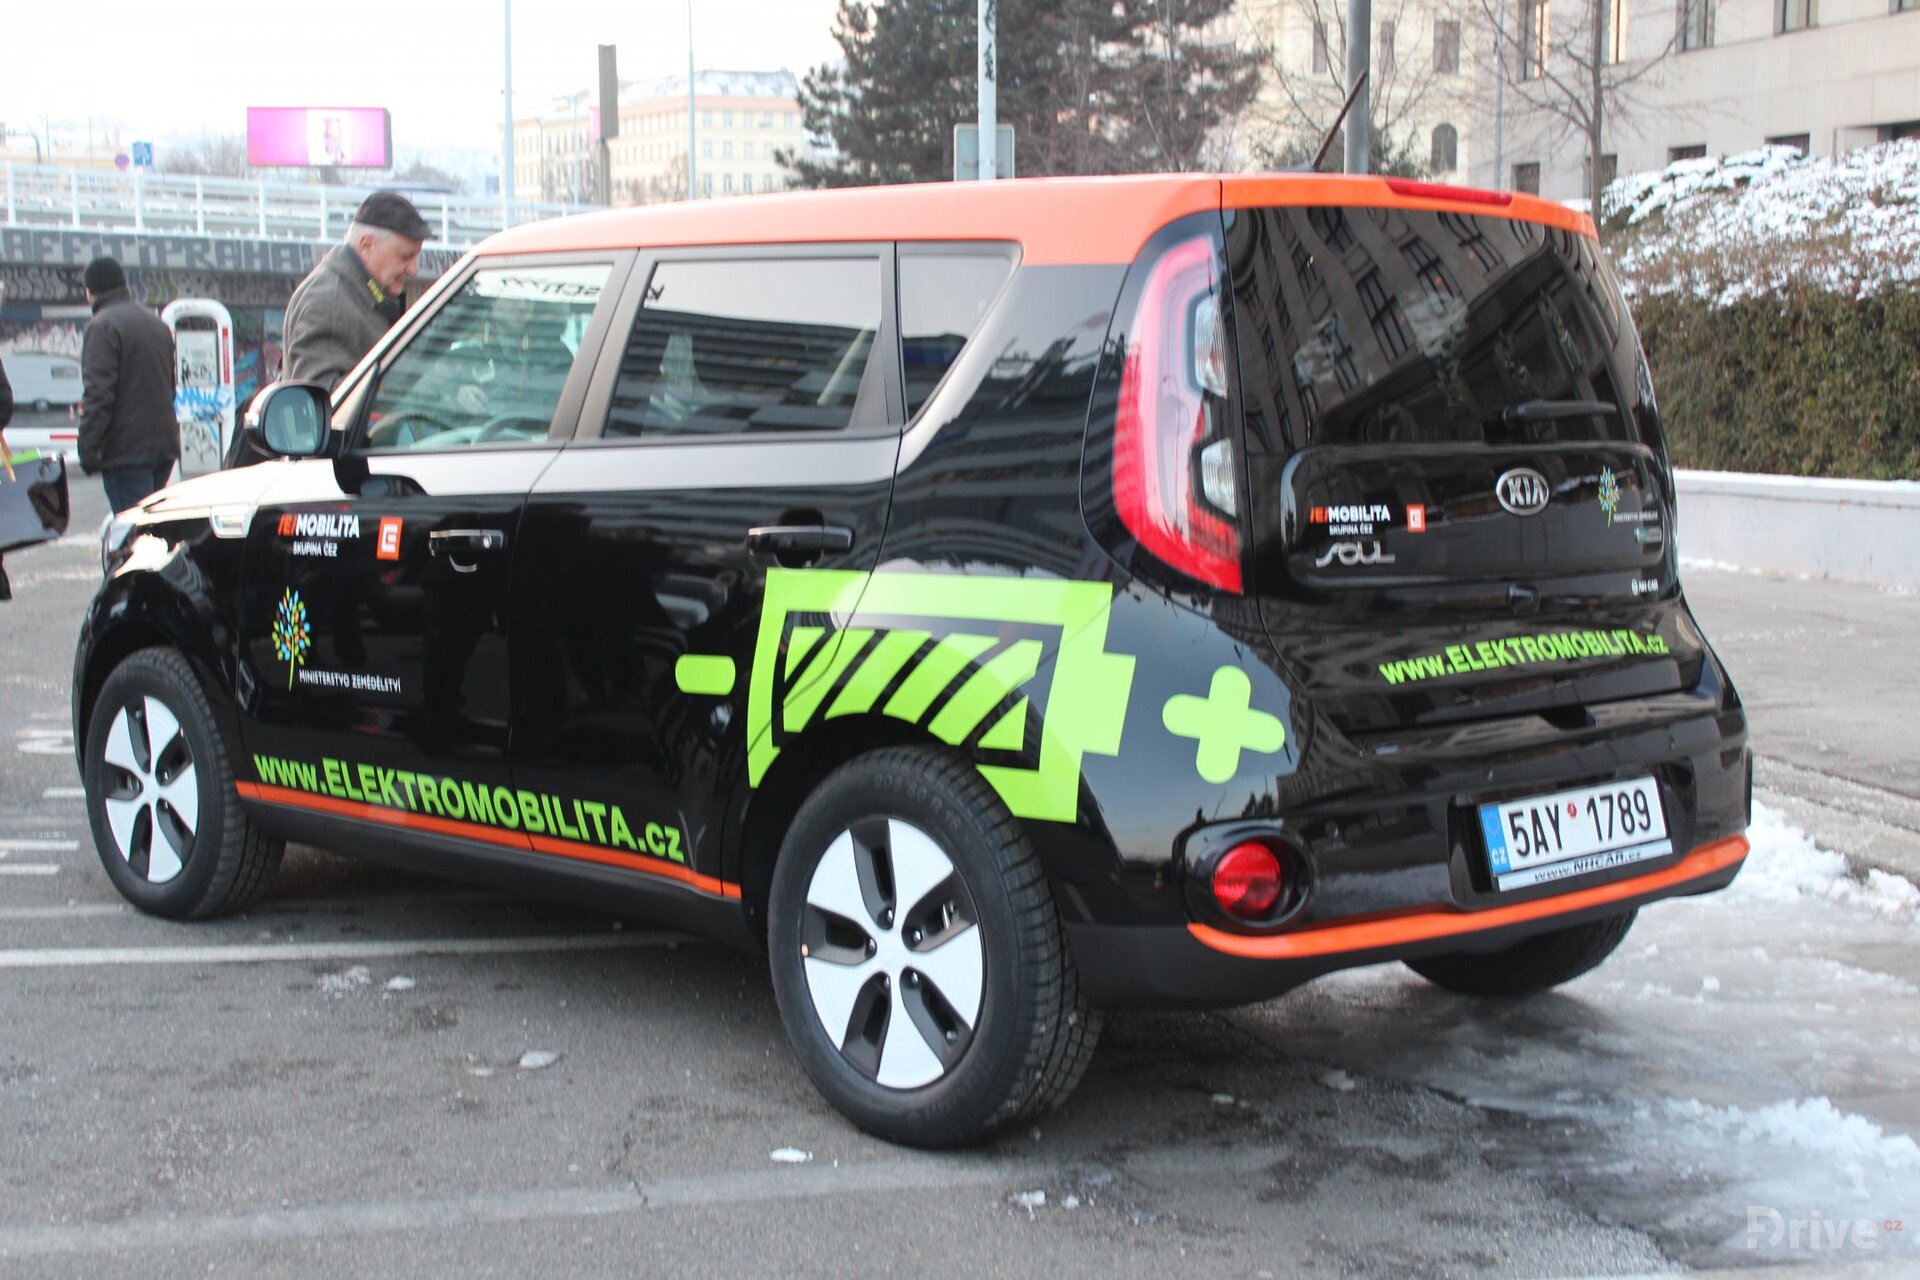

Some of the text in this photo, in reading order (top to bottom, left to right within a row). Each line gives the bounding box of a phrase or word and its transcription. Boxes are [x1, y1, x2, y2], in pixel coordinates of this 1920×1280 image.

[1507, 477, 1544, 505] KIA
[1329, 523, 1358, 535] SKUPINA
[293, 540, 322, 556] SKUPINA
[299, 668, 350, 688] MINISTERSTVO
[1508, 789, 1651, 857] 5AY 1789
[1491, 846, 1508, 865] CZ
